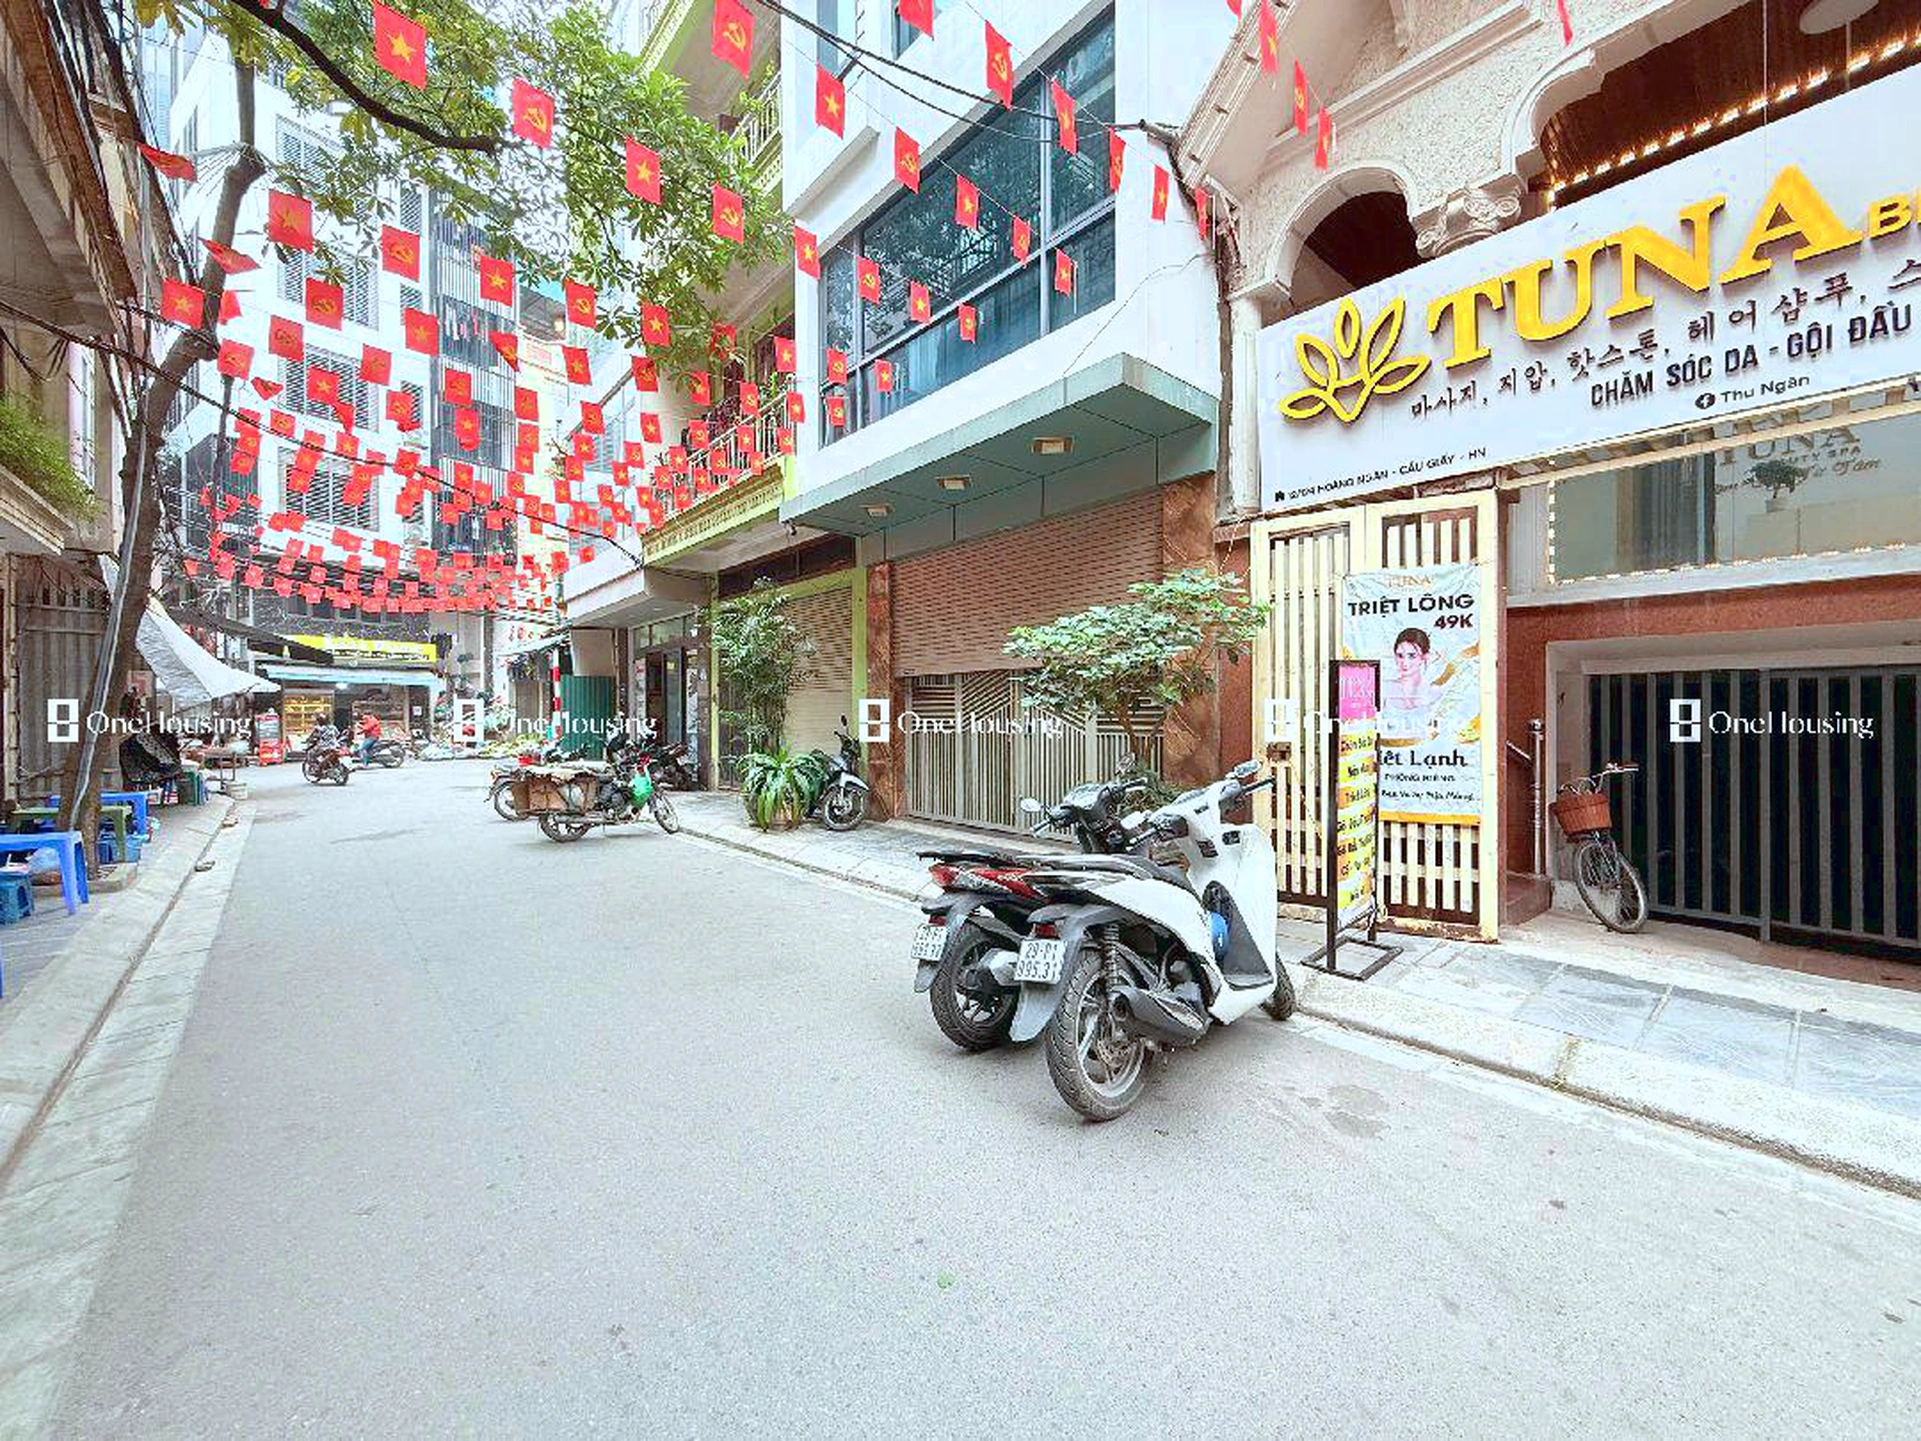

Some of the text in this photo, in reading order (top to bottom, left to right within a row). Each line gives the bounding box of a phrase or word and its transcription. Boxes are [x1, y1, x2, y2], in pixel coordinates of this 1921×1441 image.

[1427, 163, 1921, 369] TUNA B
[1592, 370, 1654, 407] CHĂM
[1666, 353, 1712, 388] SÓC
[1725, 344, 1759, 375] DA
[1787, 322, 1833, 360] GỘI
[1848, 300, 1911, 343] ĐẦU
[1721, 376, 1810, 404] Thu Ngân
[1347, 592, 1475, 618] TRIỆT LÔNG
[1434, 613, 1474, 630] 49K
